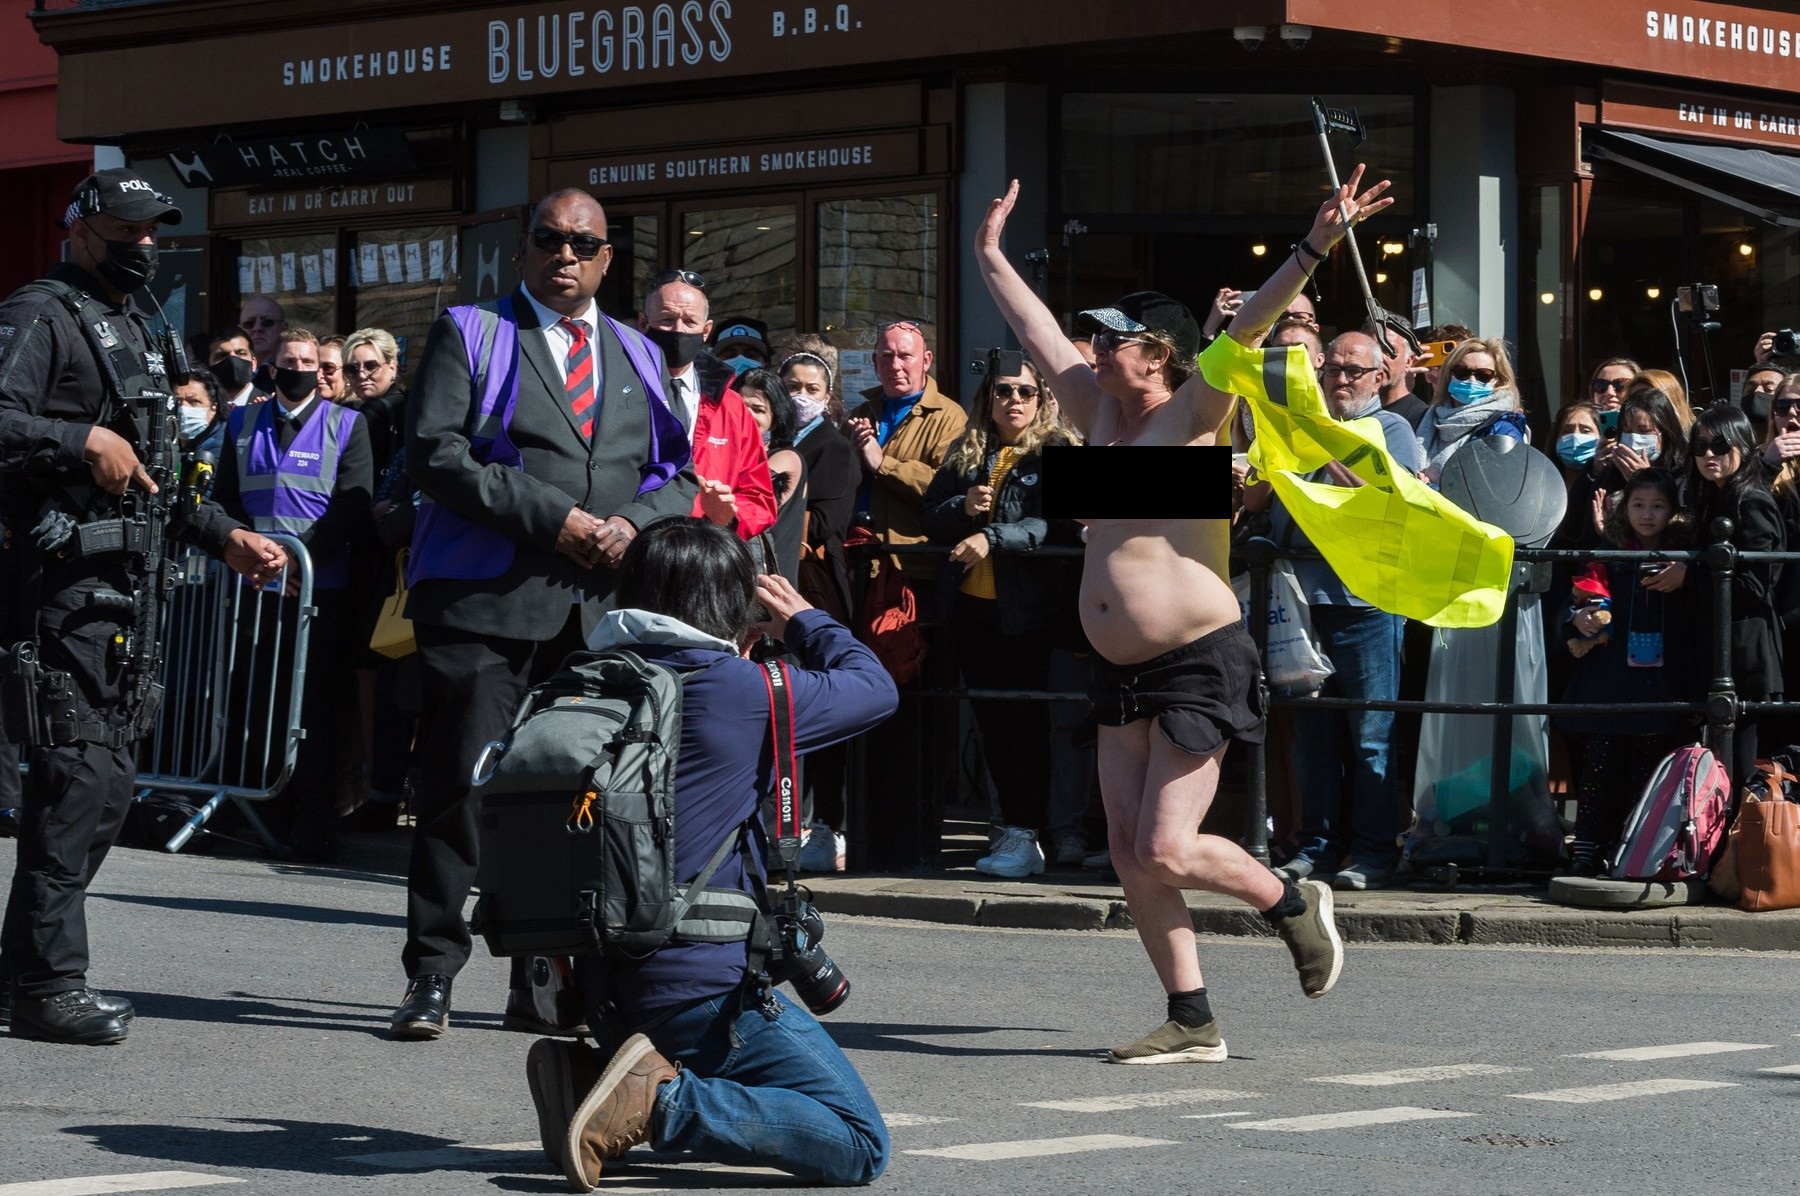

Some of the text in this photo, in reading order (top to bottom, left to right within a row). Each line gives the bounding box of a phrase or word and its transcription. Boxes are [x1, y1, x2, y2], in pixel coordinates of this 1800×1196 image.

[283, 0, 862, 86] SMOKEHOUSE BLUEGRASS B.B.Q.
[1678, 102, 1800, 136] EAT IN OR CARR
[238, 136, 366, 168] HATCH
[589, 145, 872, 185] GENUINE SOUTHERN SMOKEHOUSE
[249, 184, 415, 214] EAT IN OR CARRY OUT
[289, 450, 320, 460] STEWARD
[780, 777, 792, 823] Canon
